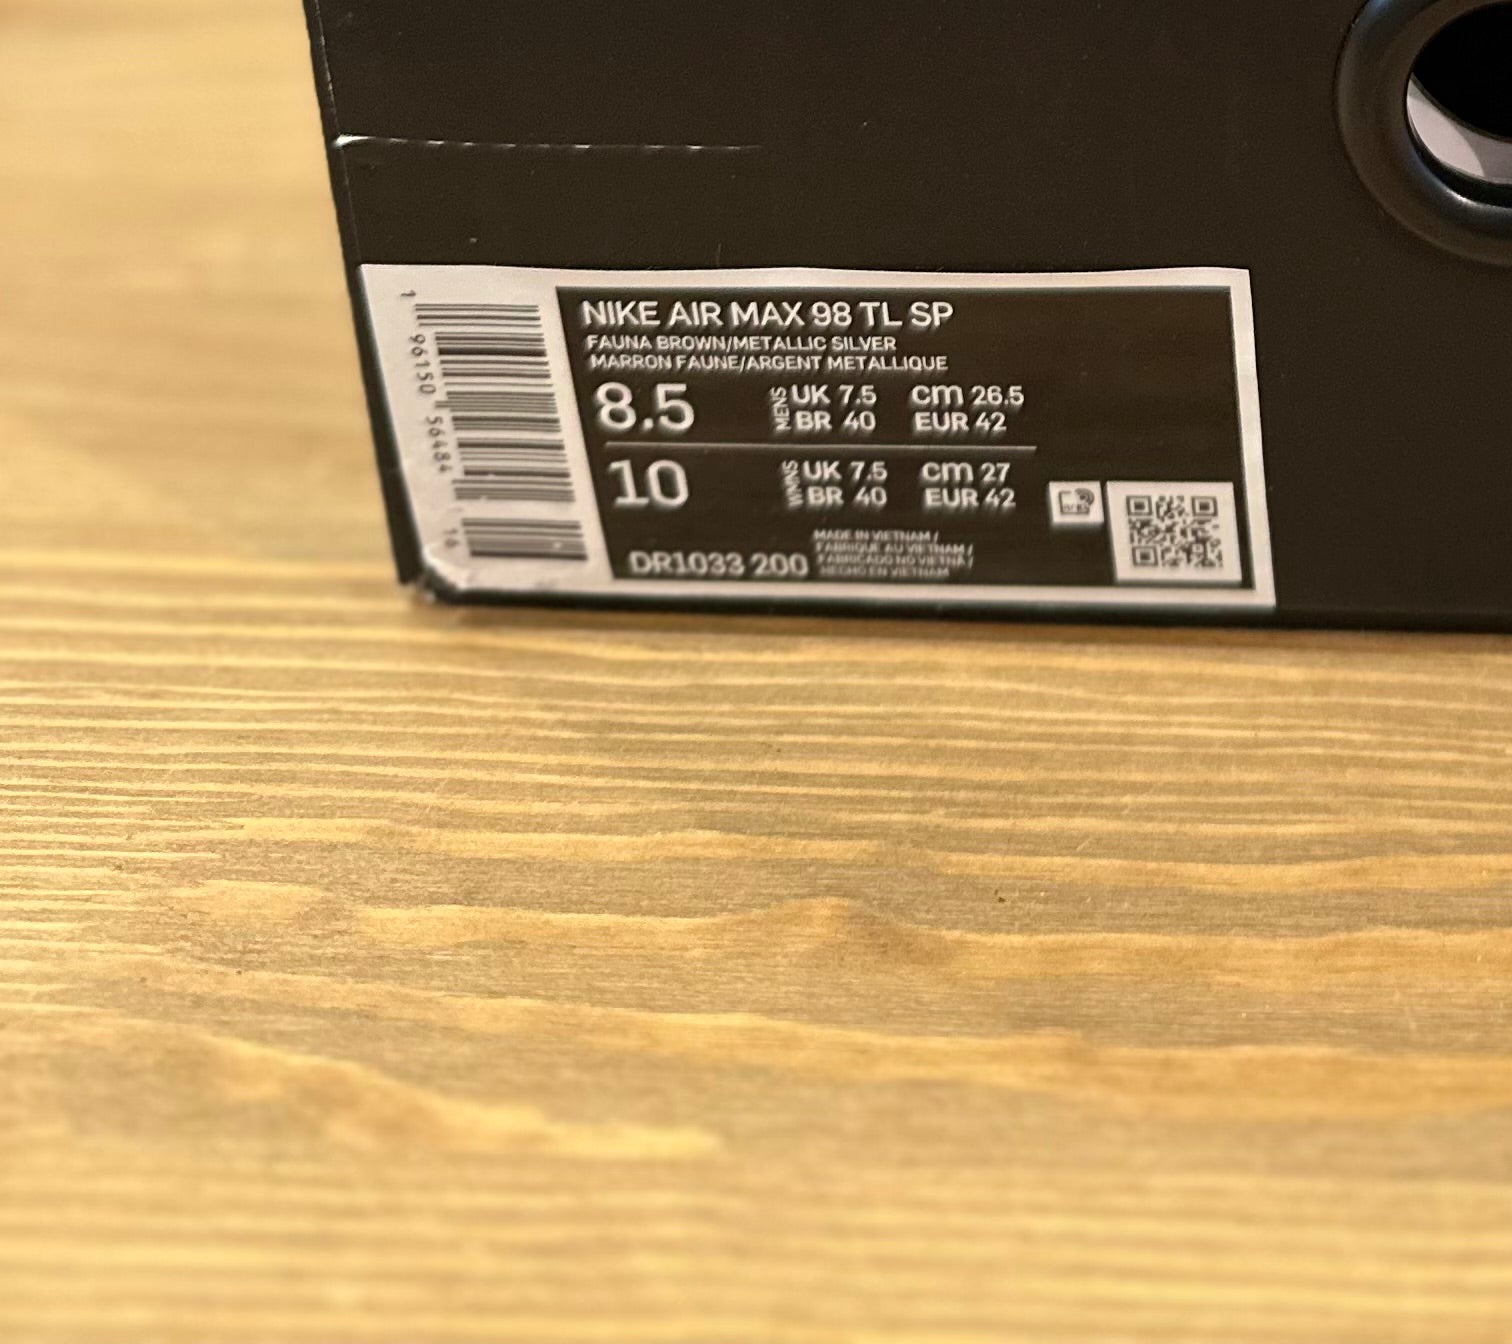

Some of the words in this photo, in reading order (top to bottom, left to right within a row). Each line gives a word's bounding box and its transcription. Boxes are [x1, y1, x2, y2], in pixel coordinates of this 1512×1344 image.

[582, 300, 661, 326] NIKE
[669, 300, 724, 326] AIR
[731, 301, 806, 327] MAX
[811, 301, 853, 327] 98
[859, 301, 903, 327] TL
[911, 301, 954, 327] SP
[586, 334, 653, 350] FAUNA
[655, 335, 827, 353] BROWN/METALLIC
[831, 336, 897, 352] SILVER
[408, 333, 437, 394] 96150
[590, 354, 673, 370] MARRON
[675, 355, 822, 373] FAUNE/ARGENT
[828, 356, 949, 372] METALLIQUE
[596, 381, 695, 431] 8.5
[792, 384, 831, 405] UK
[839, 385, 877, 405] 7.5
[972, 385, 1025, 406] 26.5
[771, 386, 791, 432] MENS
[795, 411, 832, 431] BR
[843, 411, 877, 431] 40
[915, 412, 969, 432] EUR
[975, 412, 1008, 432] 42
[609, 459, 690, 507] 10
[803, 461, 842, 480] UK
[850, 461, 888, 480] 7.5
[981, 462, 1011, 482] 27
[807, 486, 844, 506] BR
[855, 486, 888, 506] 40
[924, 488, 979, 508] EUR
[984, 488, 1017, 508] 42
[628, 551, 746, 577] DR1033
[751, 553, 809, 577] 200
